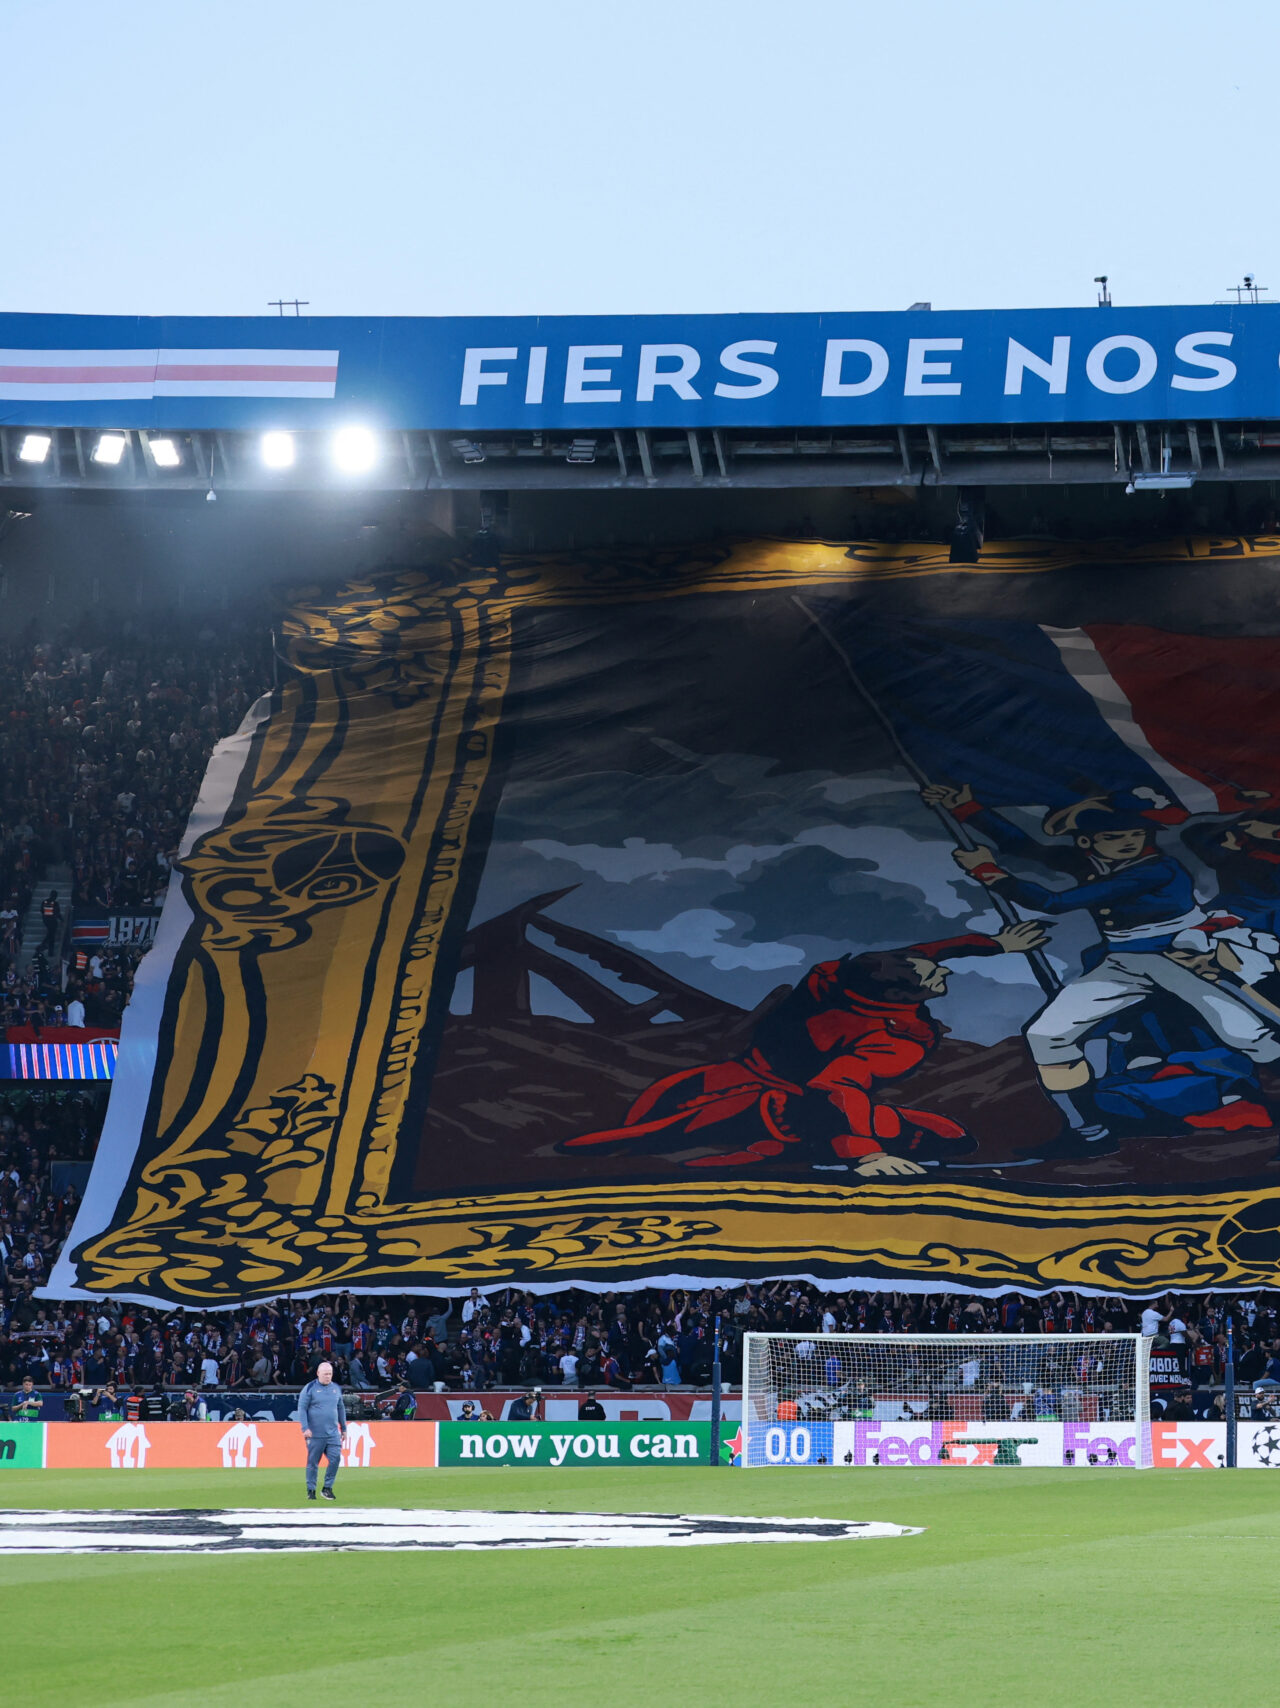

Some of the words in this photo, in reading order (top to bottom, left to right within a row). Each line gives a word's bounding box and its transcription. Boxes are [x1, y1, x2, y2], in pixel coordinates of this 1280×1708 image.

[460, 340, 779, 405] FIERS
[821, 338, 963, 397] DE
[1004, 332, 1237, 395] NOS
[459, 1434, 542, 1458] now
[549, 1434, 620, 1466] you
[629, 1434, 699, 1458] can
